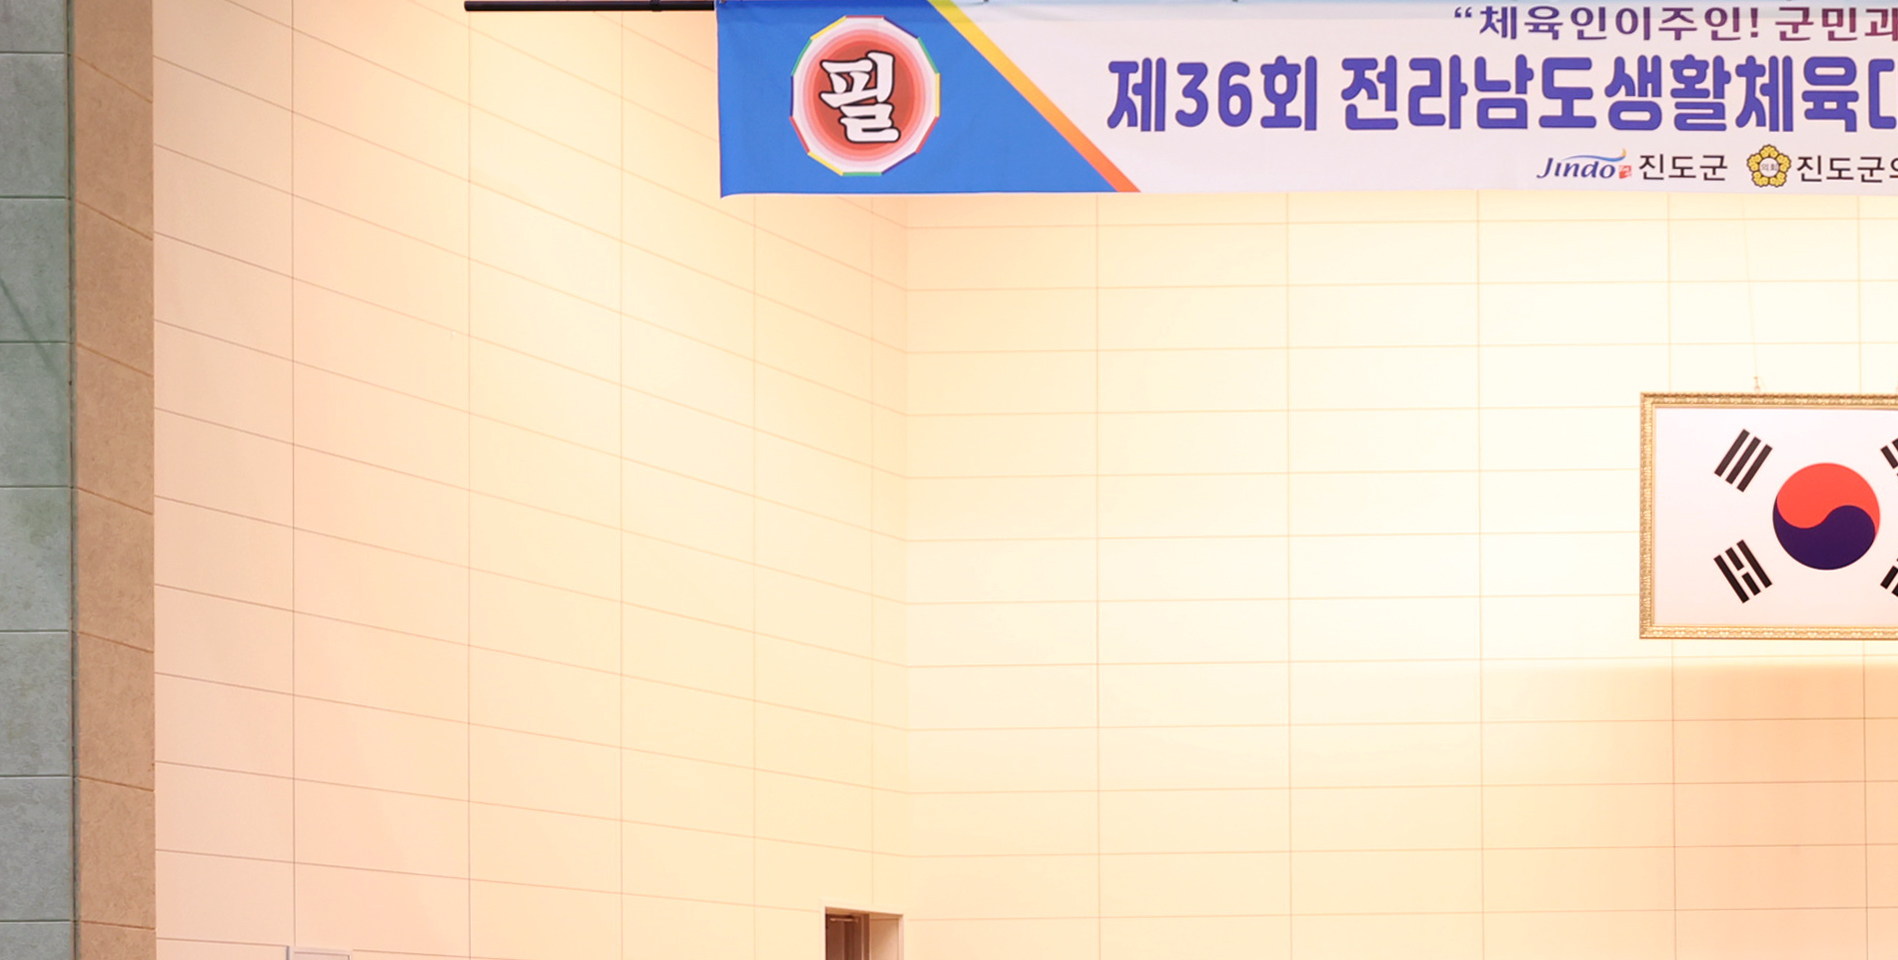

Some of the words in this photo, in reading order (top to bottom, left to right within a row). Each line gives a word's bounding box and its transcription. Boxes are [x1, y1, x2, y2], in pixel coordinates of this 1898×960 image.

[1453, 6, 1759, 41] “체육인이주인!
[819, 50, 901, 143] 필
[1106, 54, 1318, 132] 제36회
[1536, 157, 1616, 179] Jindo
[1638, 153, 1728, 181] 진도군
